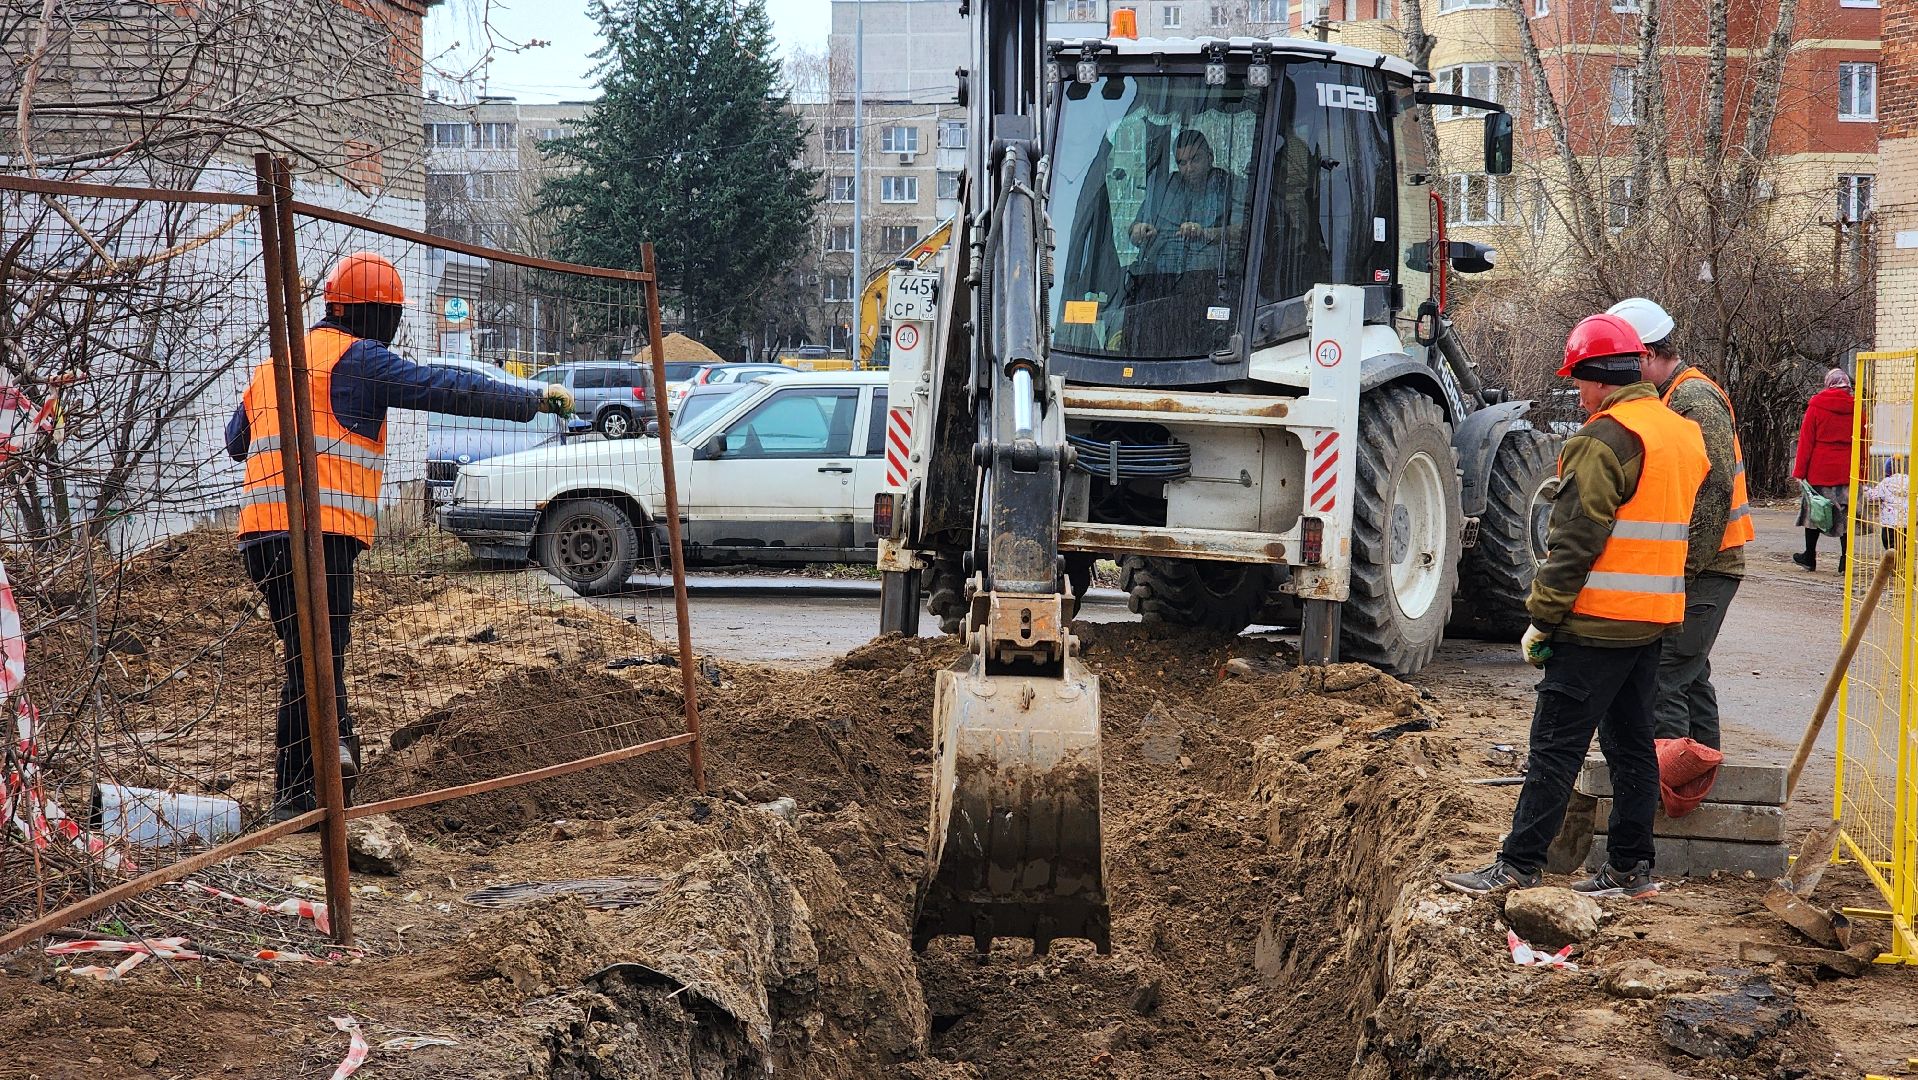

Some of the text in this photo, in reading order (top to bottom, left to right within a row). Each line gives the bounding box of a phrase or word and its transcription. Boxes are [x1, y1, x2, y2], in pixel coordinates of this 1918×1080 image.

[899, 331, 914, 344] 40
[1320, 348, 1337, 361] 40
[1437, 354, 1467, 423] HIDRO
